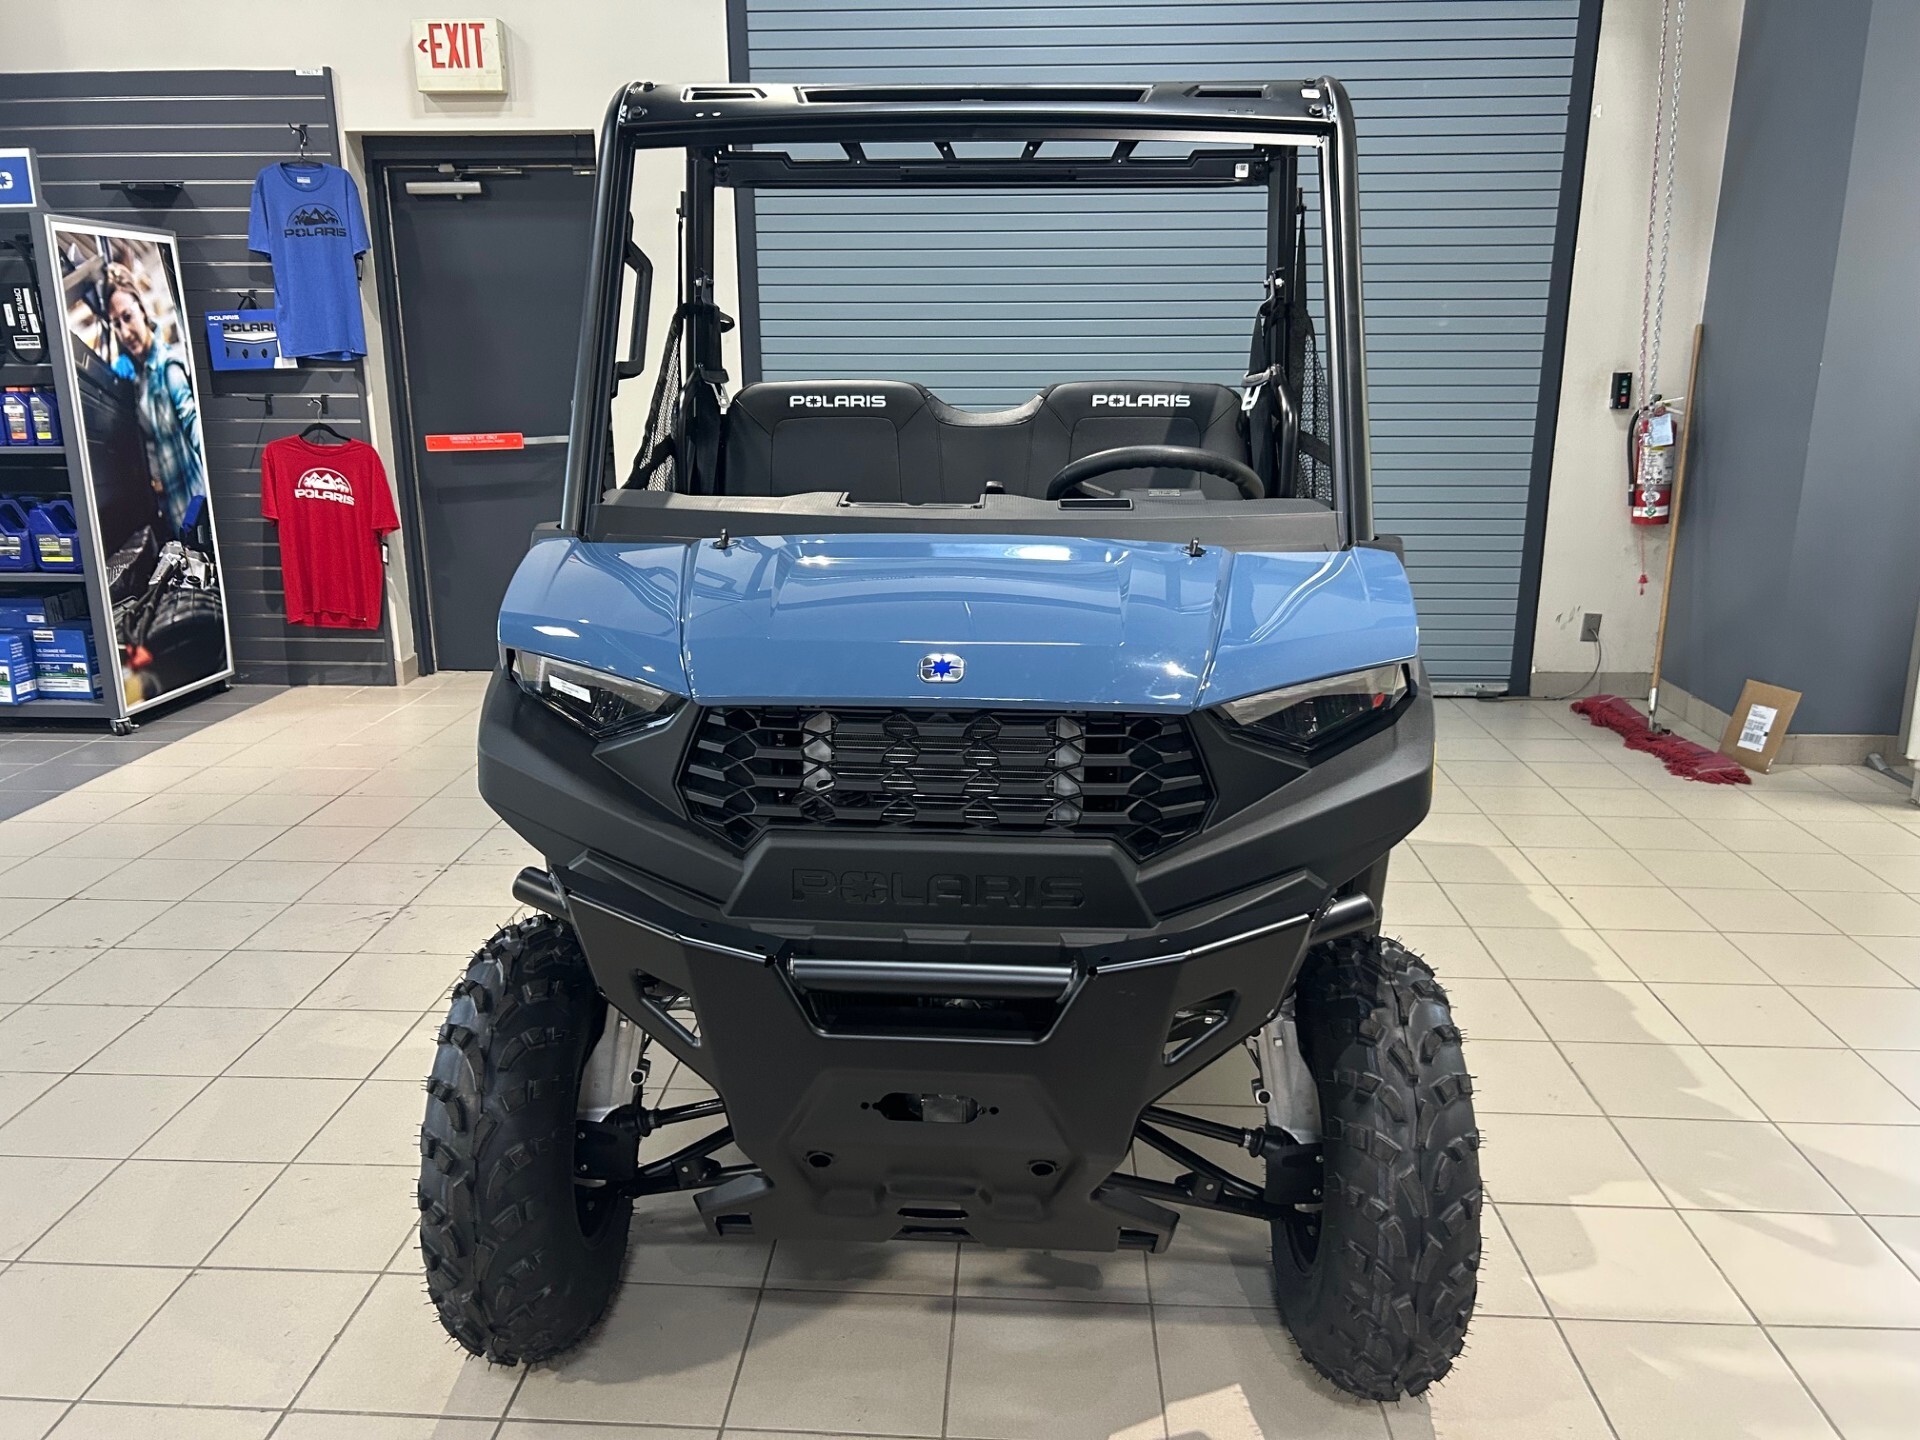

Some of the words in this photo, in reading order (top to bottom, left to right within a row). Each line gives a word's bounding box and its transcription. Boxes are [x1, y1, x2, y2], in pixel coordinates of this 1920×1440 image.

[427, 23, 485, 69] EXIT
[284, 227, 347, 239] POLARIS
[13, 287, 25, 313] DRIVE
[18, 313, 30, 334] BELT
[222, 322, 276, 332] POLARI
[789, 395, 887, 408] POLARIS
[1091, 394, 1191, 408] POLARIS
[294, 488, 355, 506] POLARIS
[792, 867, 1087, 909] POLARIS
